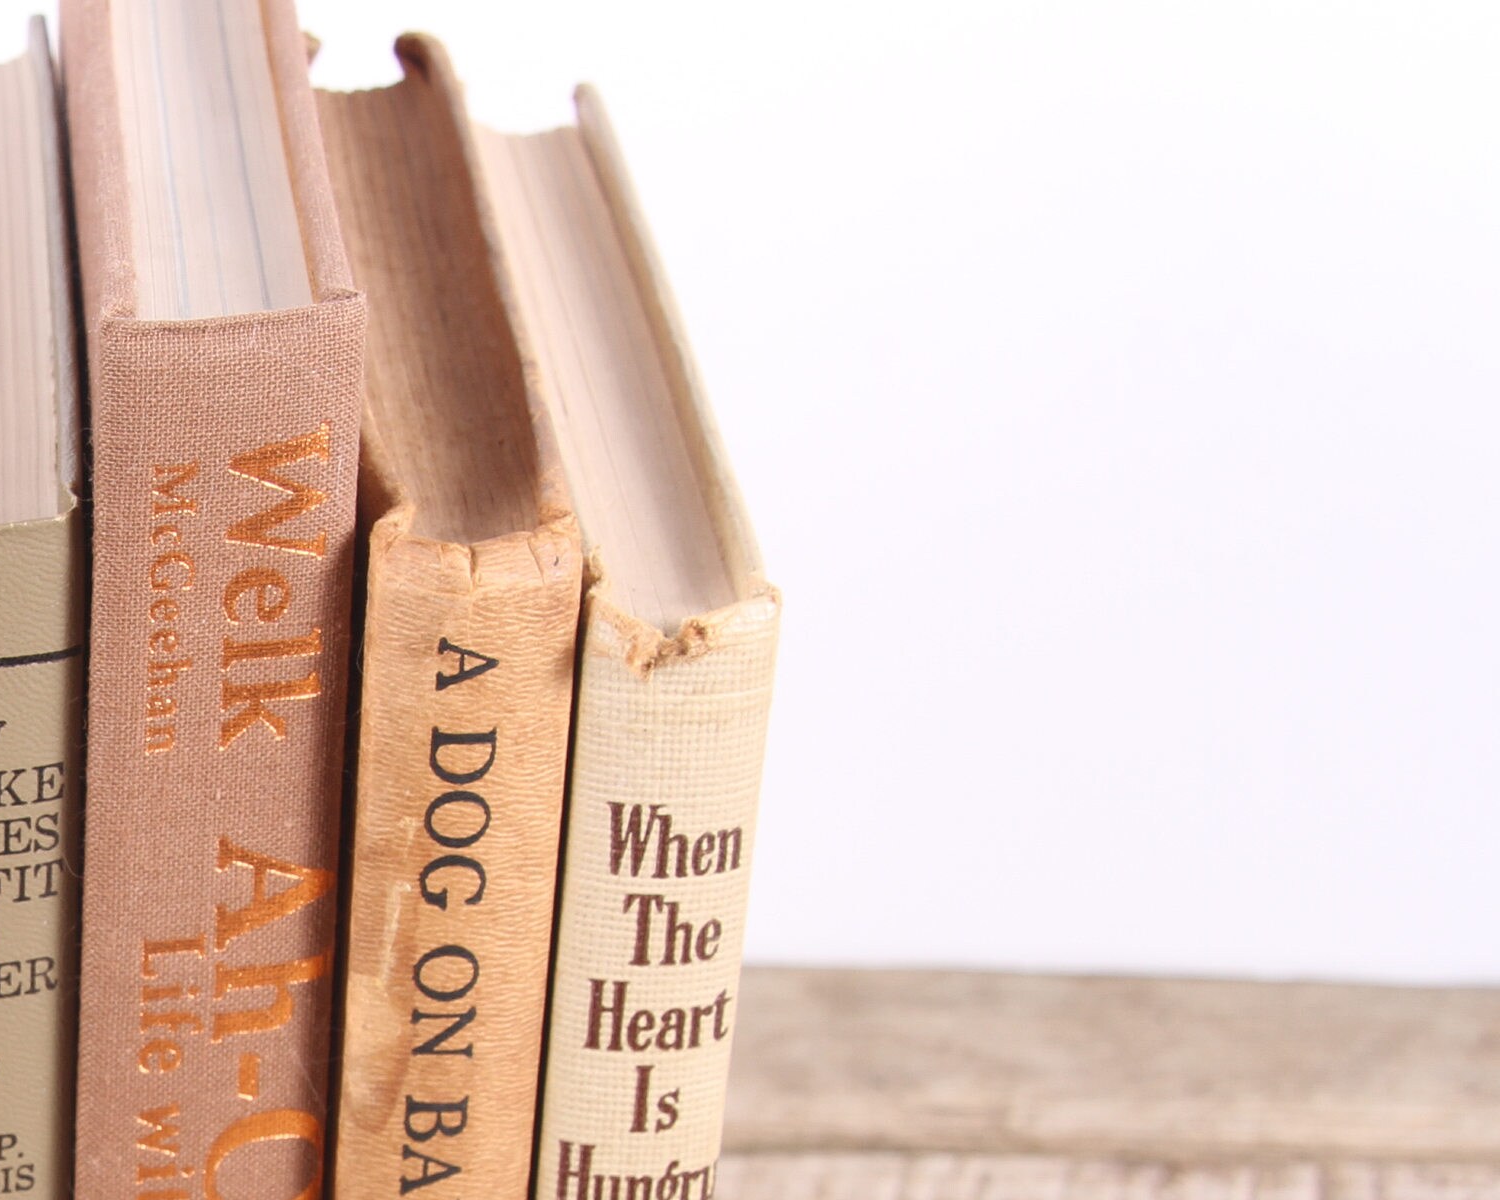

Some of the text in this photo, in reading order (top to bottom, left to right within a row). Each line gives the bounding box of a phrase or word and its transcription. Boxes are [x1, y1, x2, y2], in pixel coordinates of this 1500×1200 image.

[145, 457, 200, 757] McGeehan
[218, 418, 333, 752] Welk
[435, 636, 500, 692] A
[418, 725, 498, 912] DOG
[607, 800, 744, 880] When
[623, 892, 723, 967] The
[138, 932, 206, 1074] Life
[409, 944, 481, 1060] ON
[584, 977, 733, 1052] Heart
[629, 1064, 681, 1134] Is
